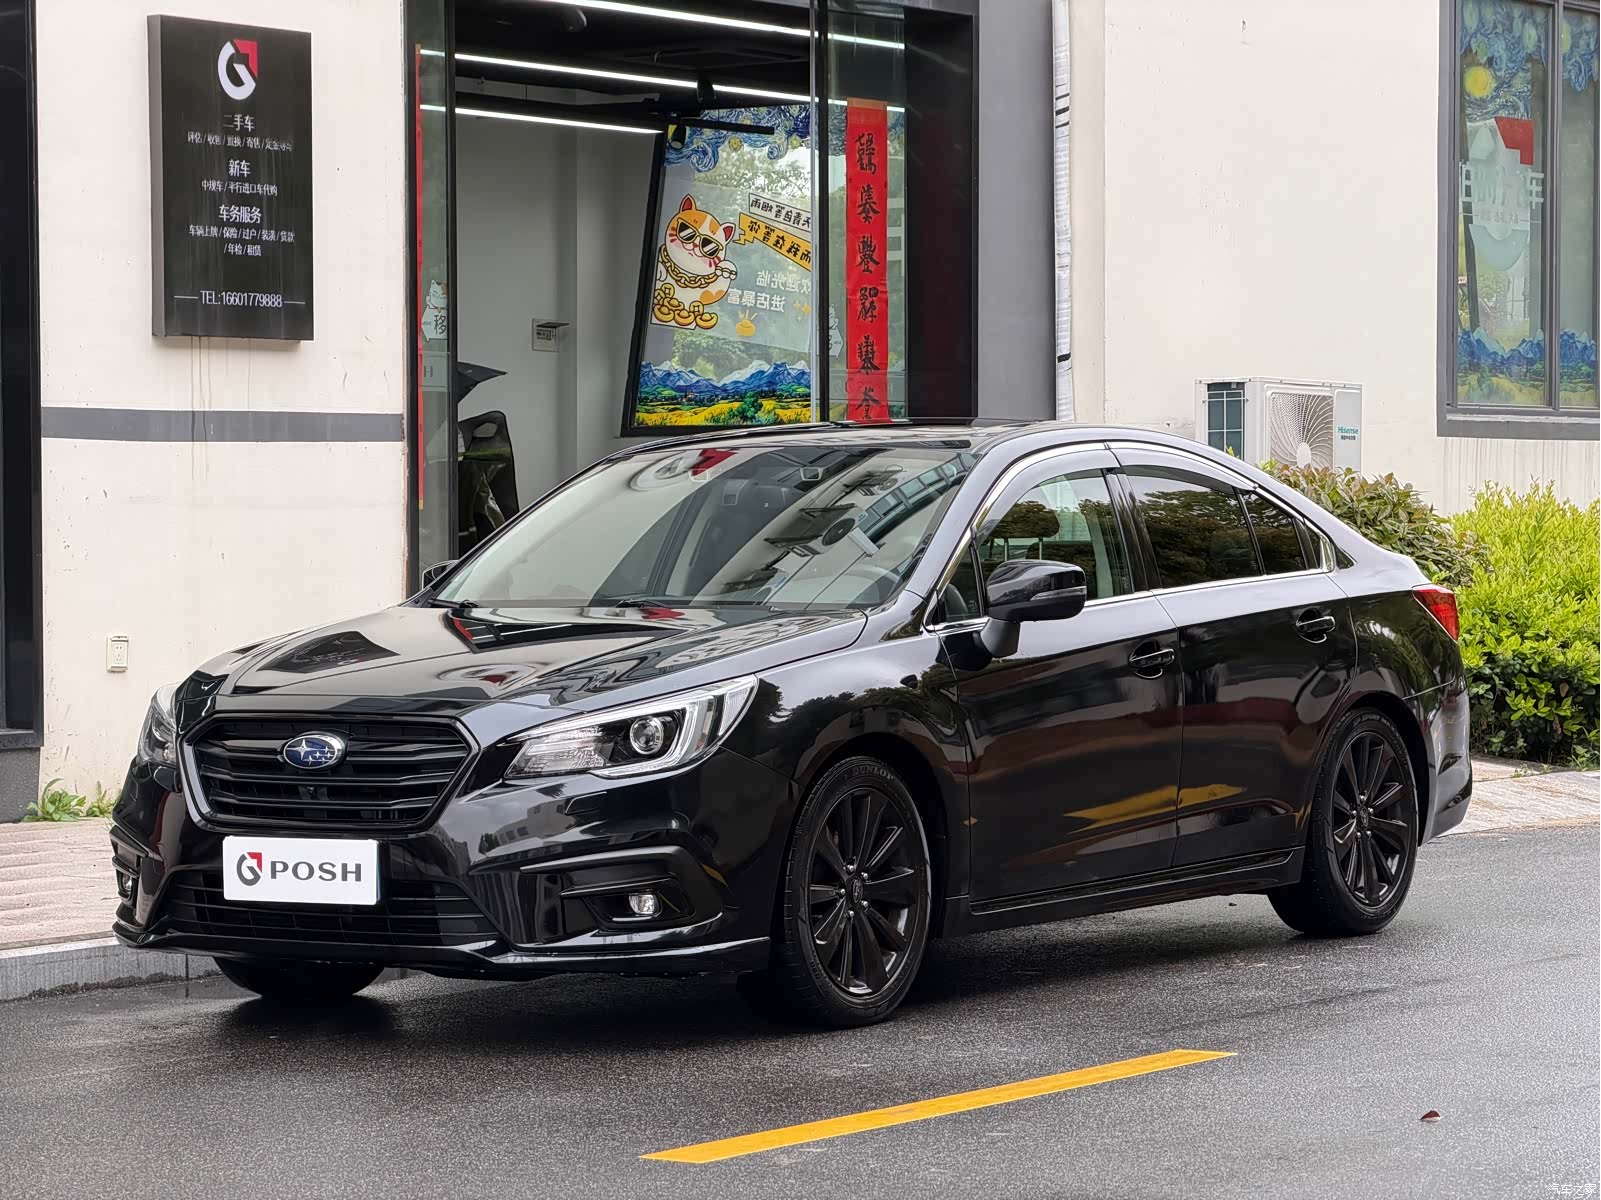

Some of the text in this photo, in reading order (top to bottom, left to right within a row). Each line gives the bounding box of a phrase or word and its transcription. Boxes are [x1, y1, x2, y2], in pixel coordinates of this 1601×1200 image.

[223, 113, 255, 132] 二手车
[228, 158, 251, 177] 新车
[218, 204, 262, 224] 车务服务
[200, 290, 283, 307] TEL:16601779888
[433, 314, 447, 335] 移
[851, 765, 895, 780] DUNLOP
[270, 860, 362, 882] POSH
